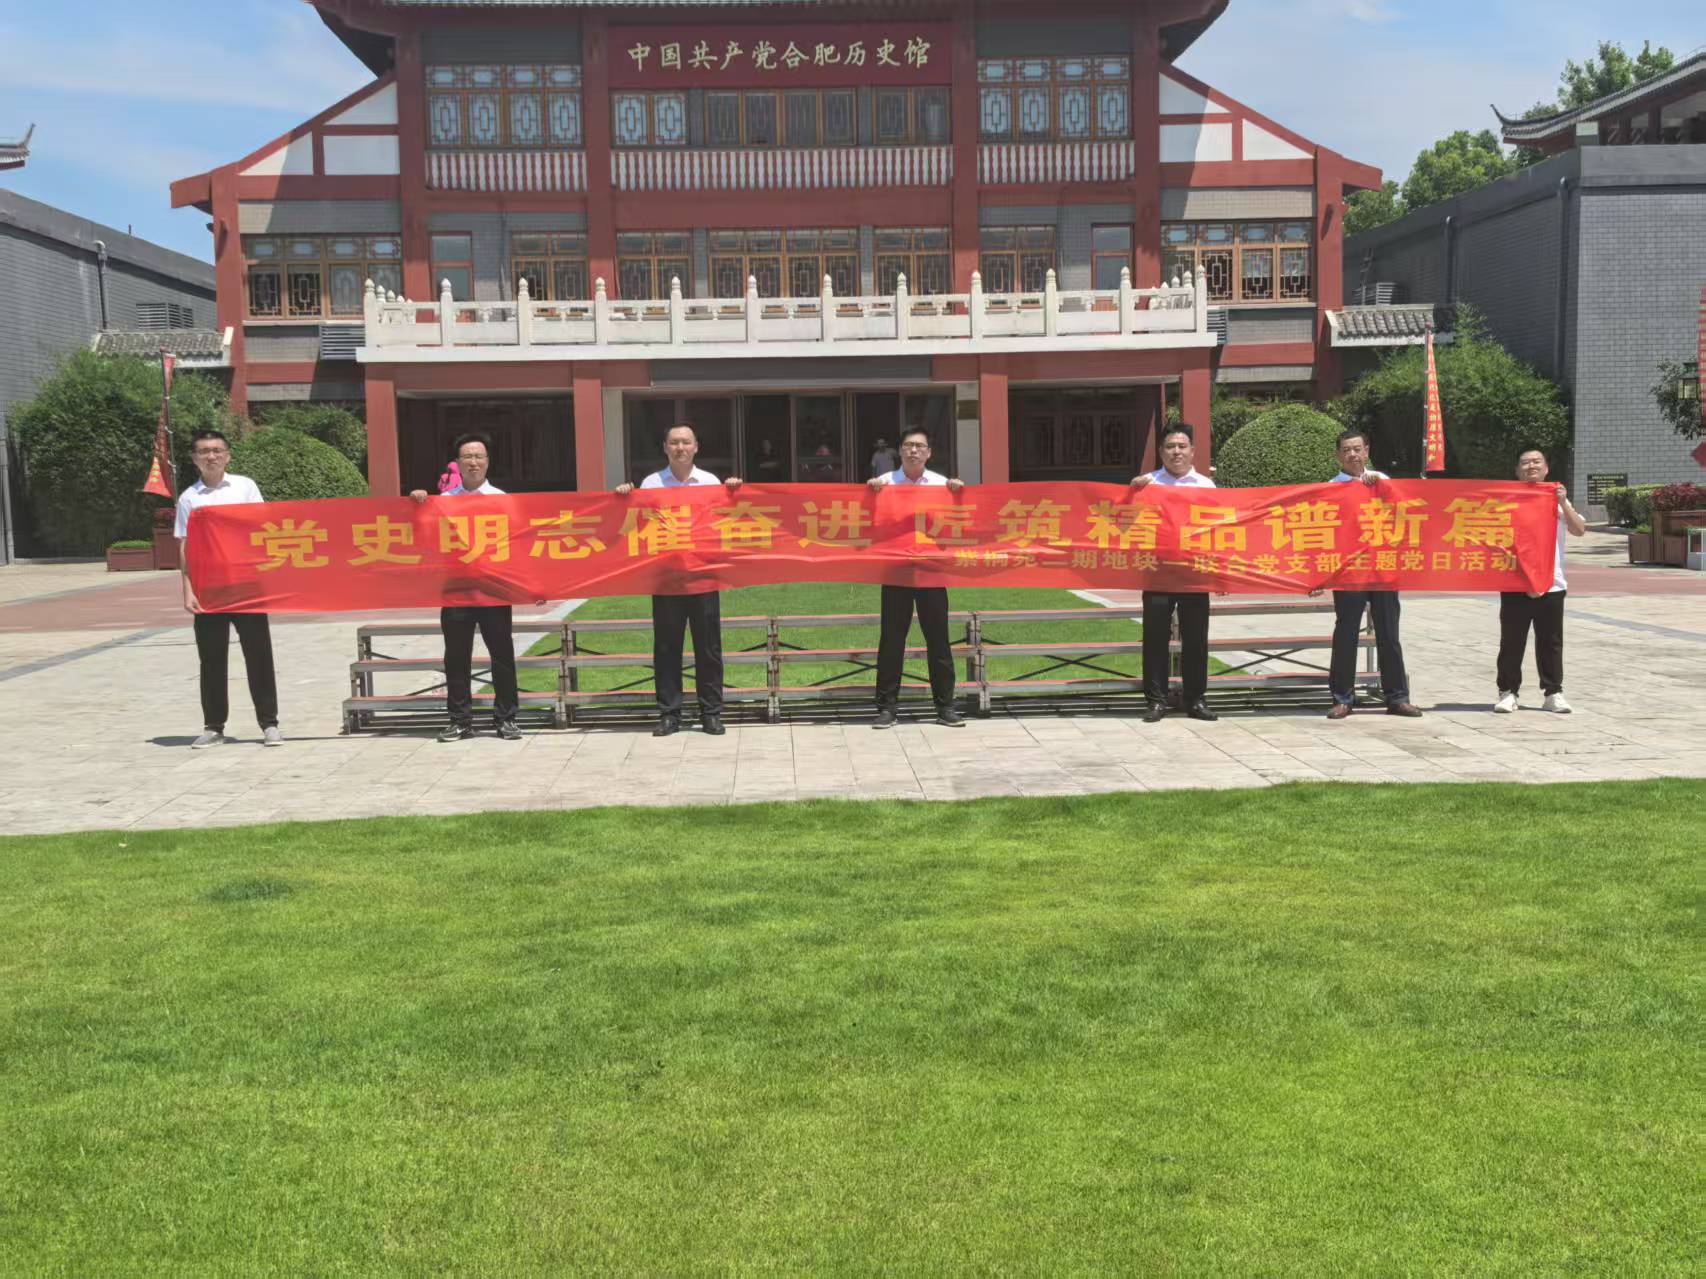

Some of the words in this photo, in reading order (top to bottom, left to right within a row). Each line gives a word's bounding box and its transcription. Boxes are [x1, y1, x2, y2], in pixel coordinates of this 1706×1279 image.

[627, 37, 931, 72] 中国共产党合肥历史馆
